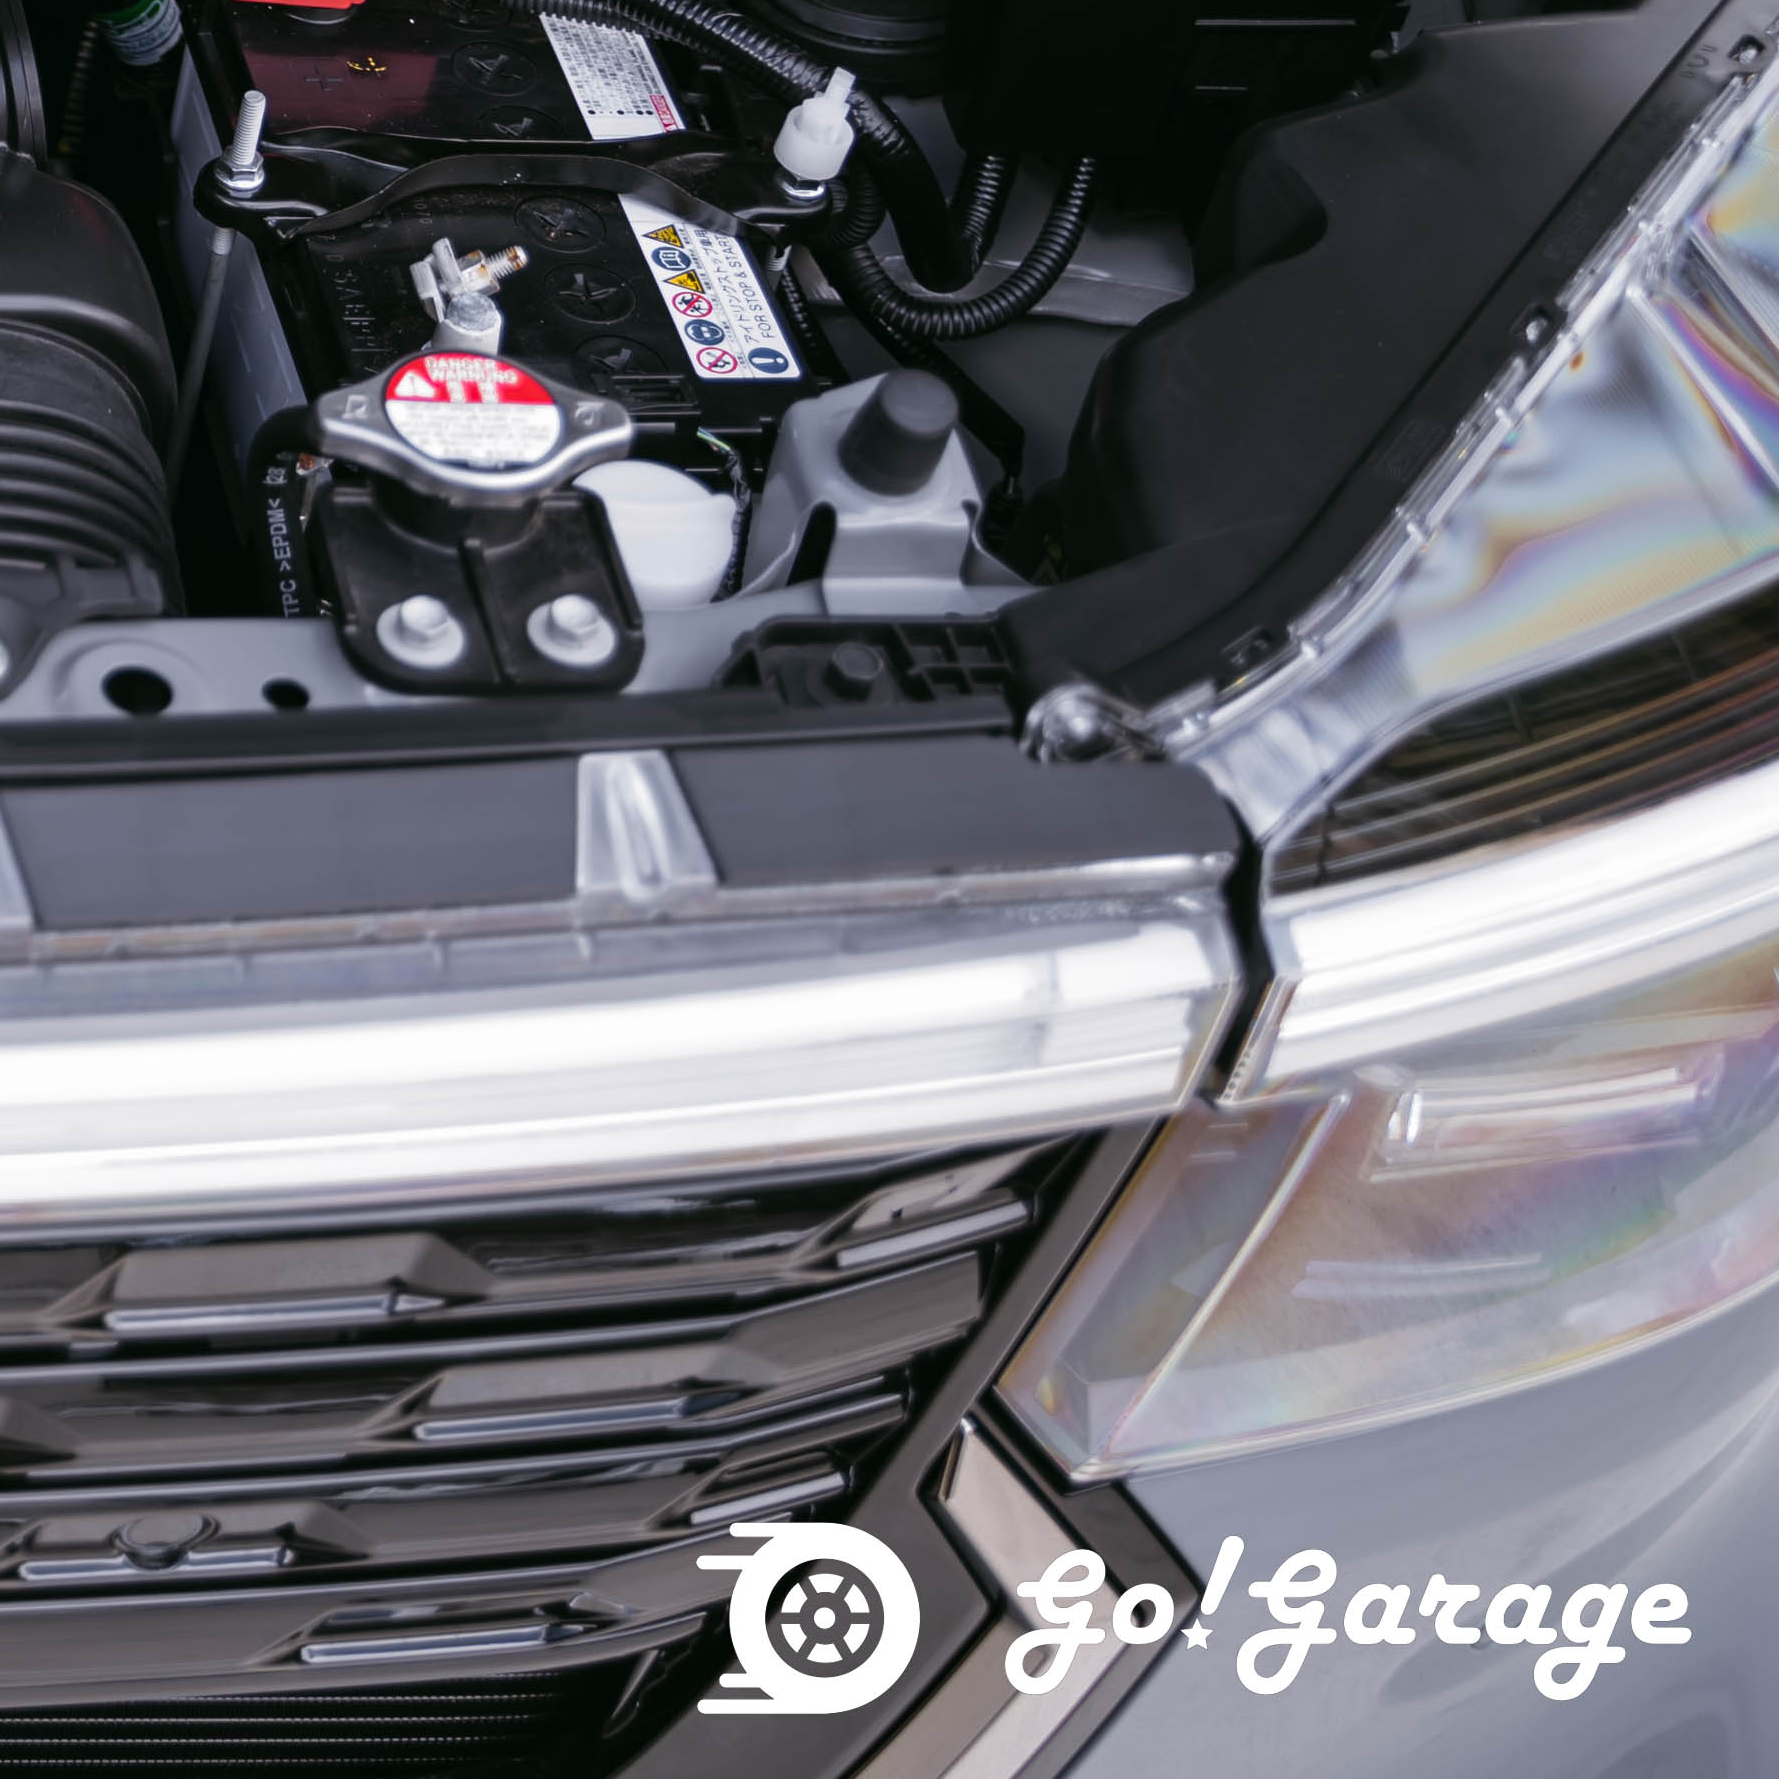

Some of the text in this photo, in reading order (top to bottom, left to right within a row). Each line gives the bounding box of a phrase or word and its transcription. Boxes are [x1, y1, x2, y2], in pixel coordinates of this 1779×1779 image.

[715, 233, 776, 339] FOR STOP & START
[425, 356, 498, 371] DANGER
[267, 497, 292, 573] >EPDM<
[279, 579, 301, 619] TPC
